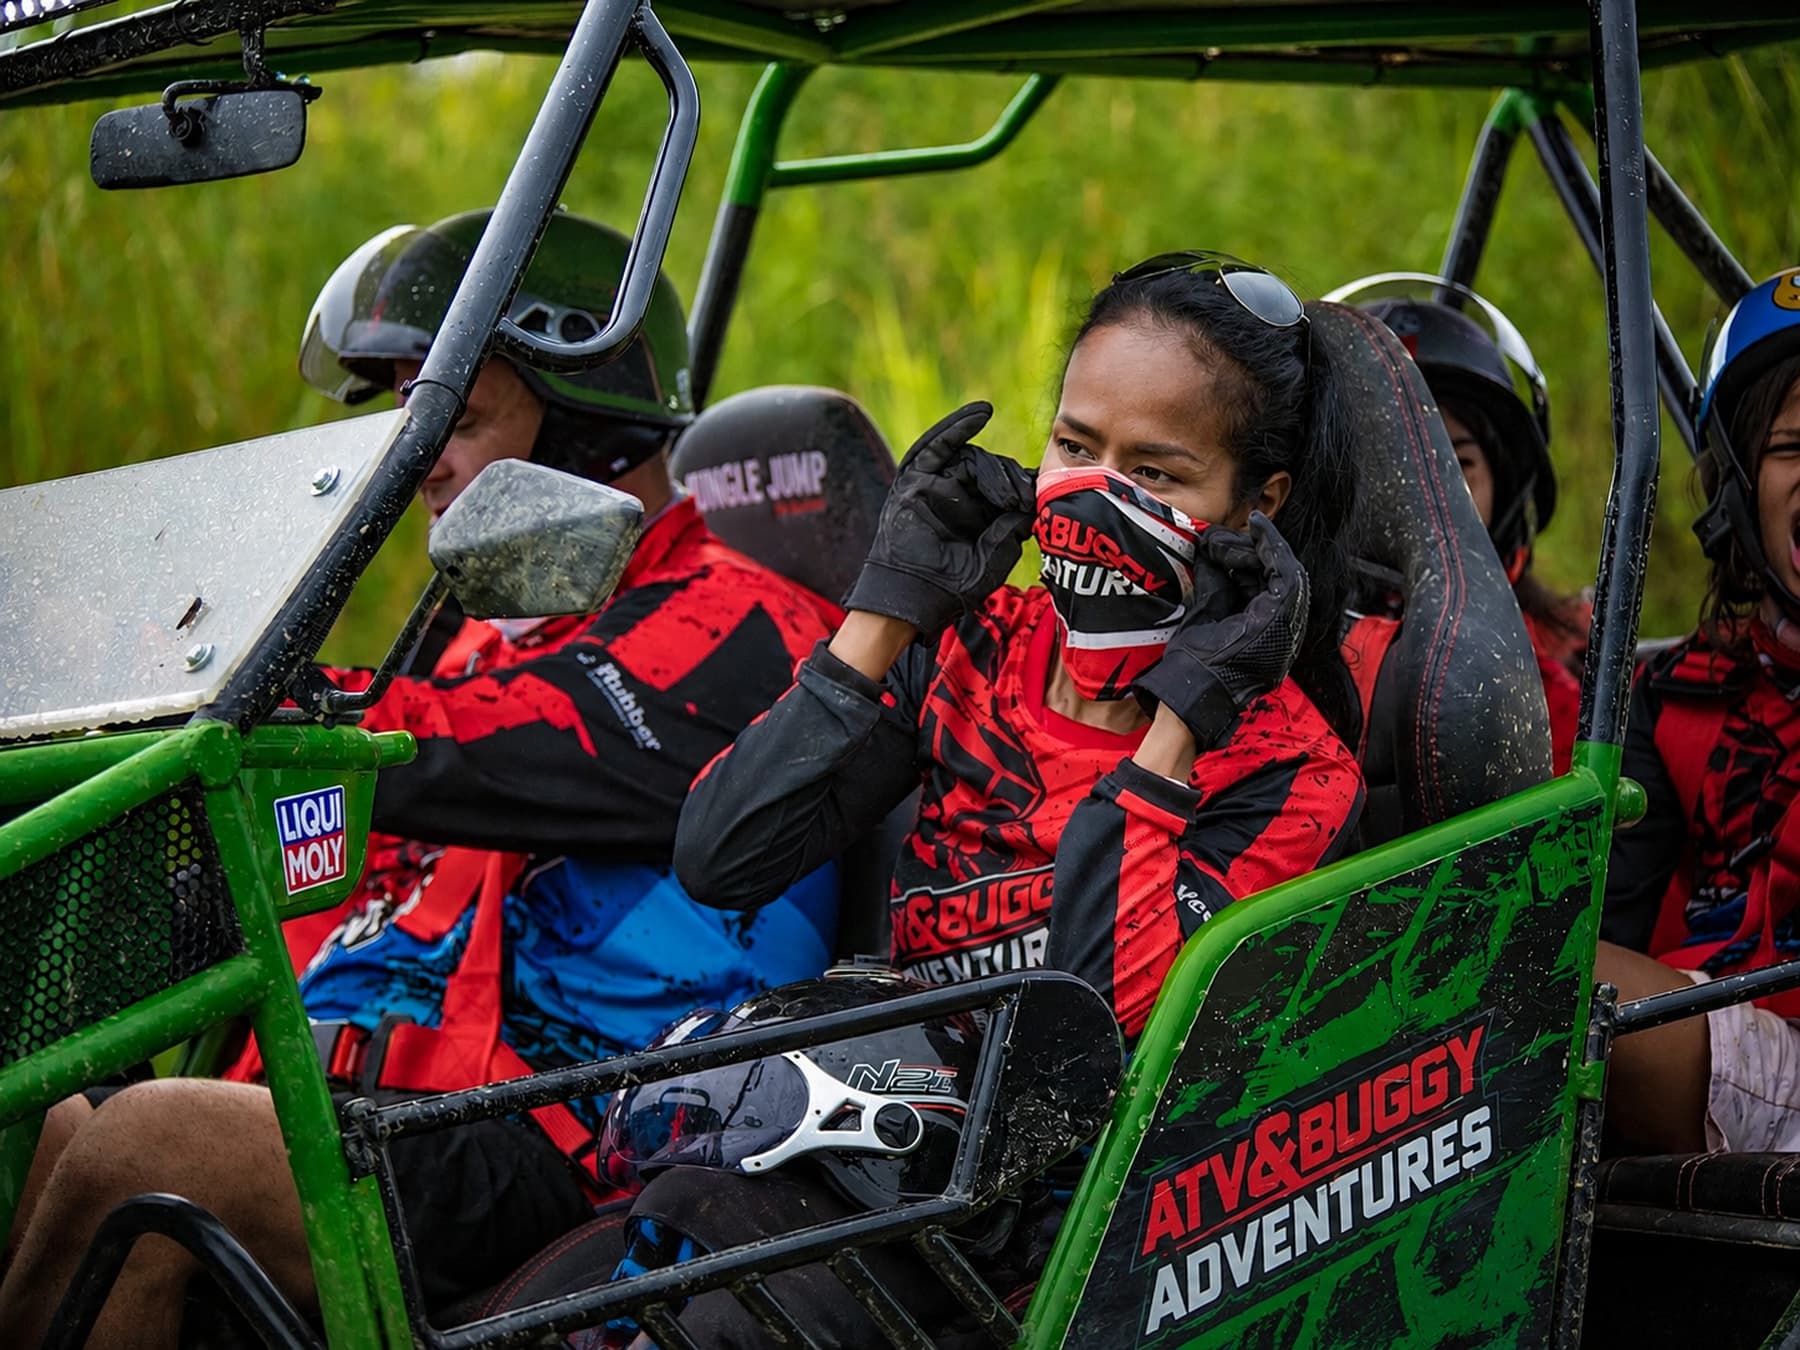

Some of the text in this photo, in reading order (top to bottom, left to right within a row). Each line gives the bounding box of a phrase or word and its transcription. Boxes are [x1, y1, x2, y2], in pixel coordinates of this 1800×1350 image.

[766, 450, 827, 500] JUMP
[280, 792, 342, 842] LIQUI
[287, 835, 343, 886] MOLY
[1141, 1024, 1485, 1256] ATV&BUGGY
[1145, 1105, 1492, 1336] ADVENTURES
